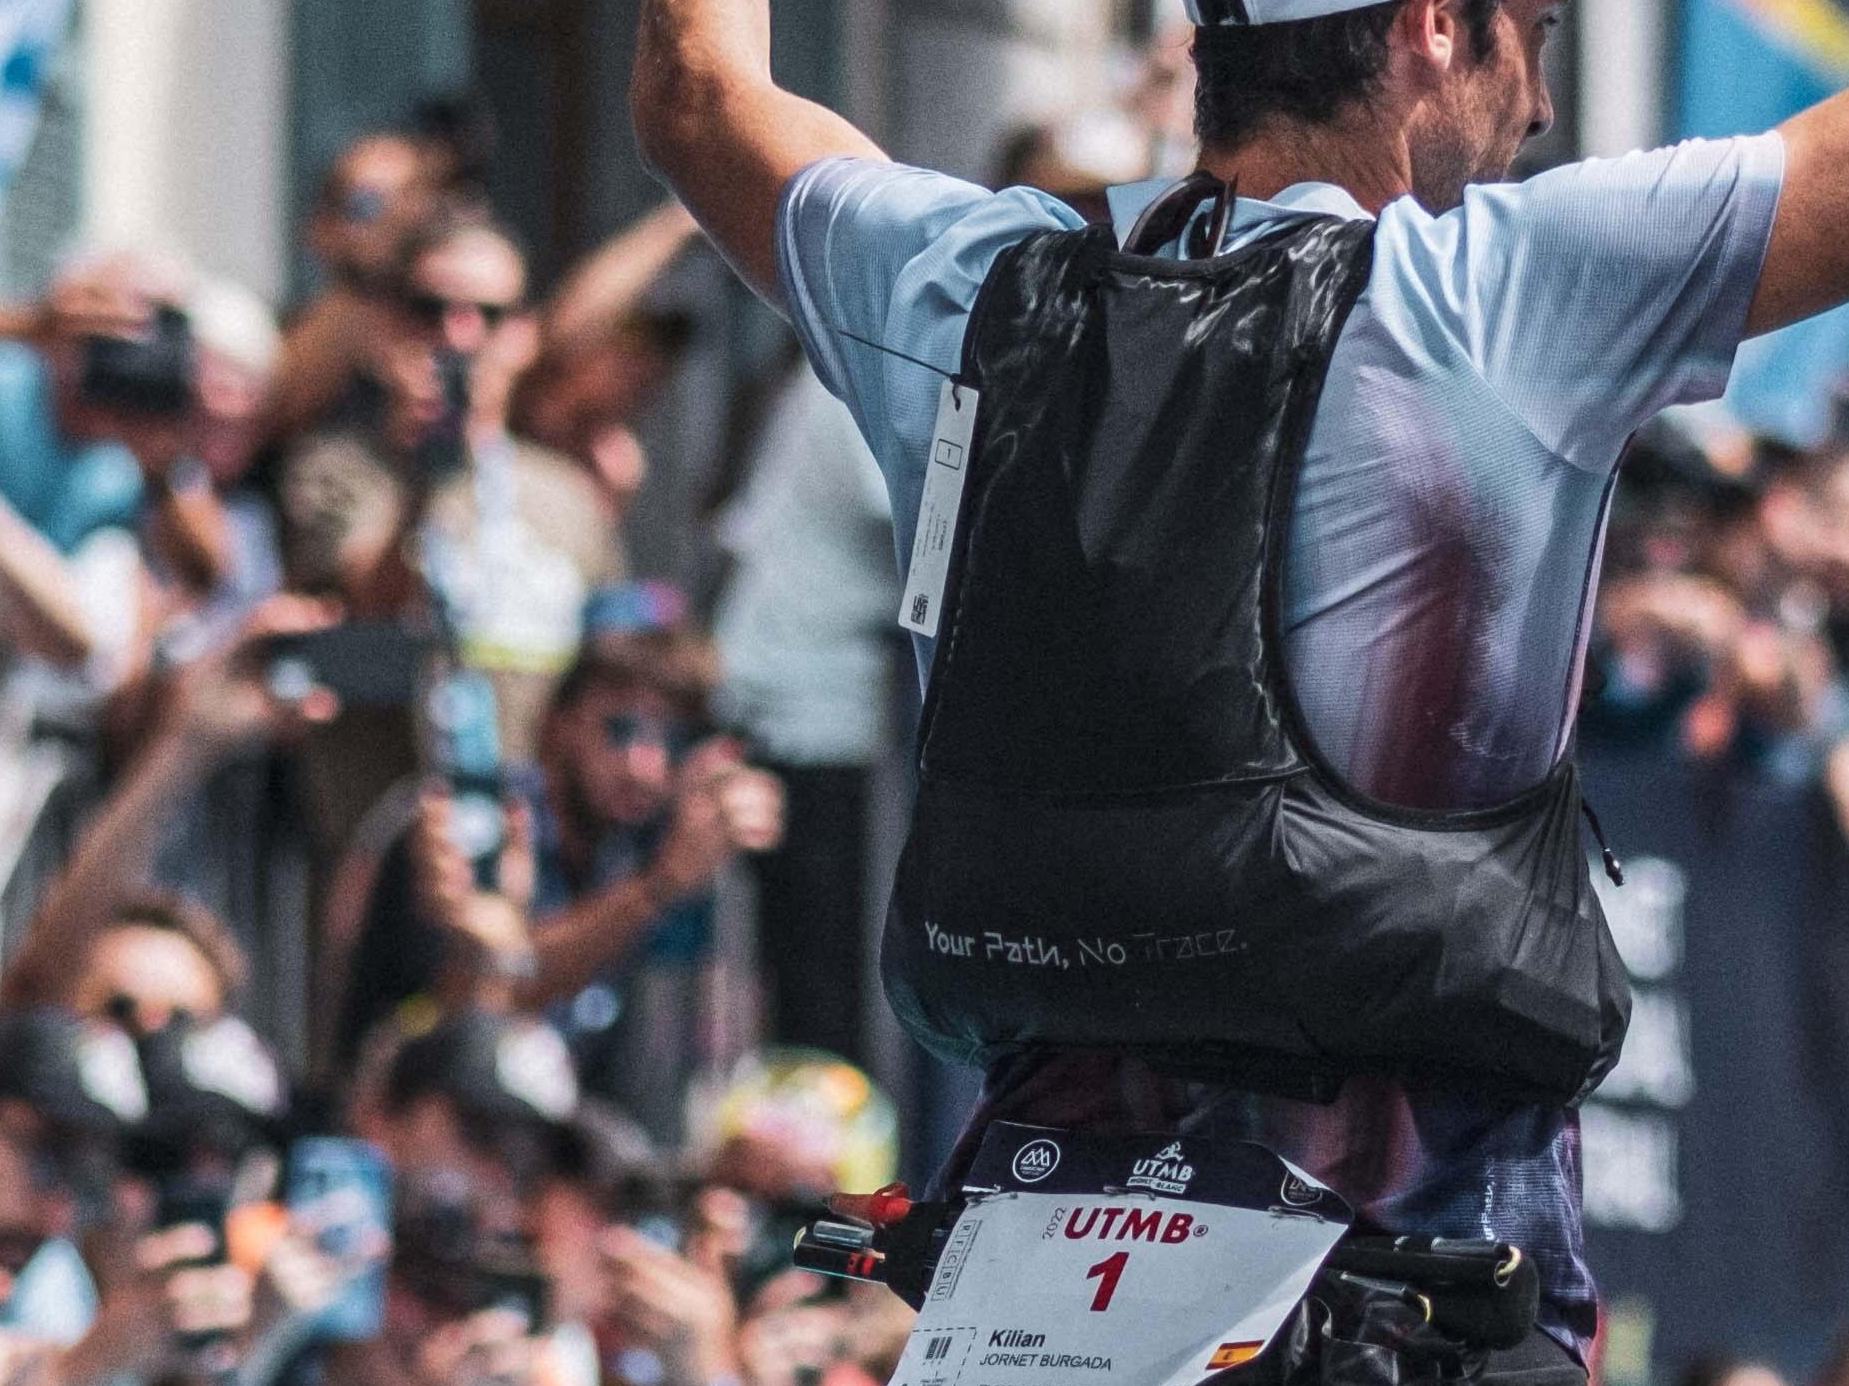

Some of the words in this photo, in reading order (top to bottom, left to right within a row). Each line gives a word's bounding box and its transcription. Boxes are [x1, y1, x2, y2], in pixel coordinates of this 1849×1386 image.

[925, 920, 976, 957] Your
[984, 931, 1069, 970] Path,
[1077, 936, 1127, 966] No
[1132, 1158, 1193, 1182] UTMB
[1041, 1206, 1068, 1241] 2022
[1085, 1251, 1130, 1312] 1
[987, 1329, 1046, 1349] Kilian
[979, 1352, 1038, 1367] JORNET
[1039, 1353, 1112, 1372] BURGADA
